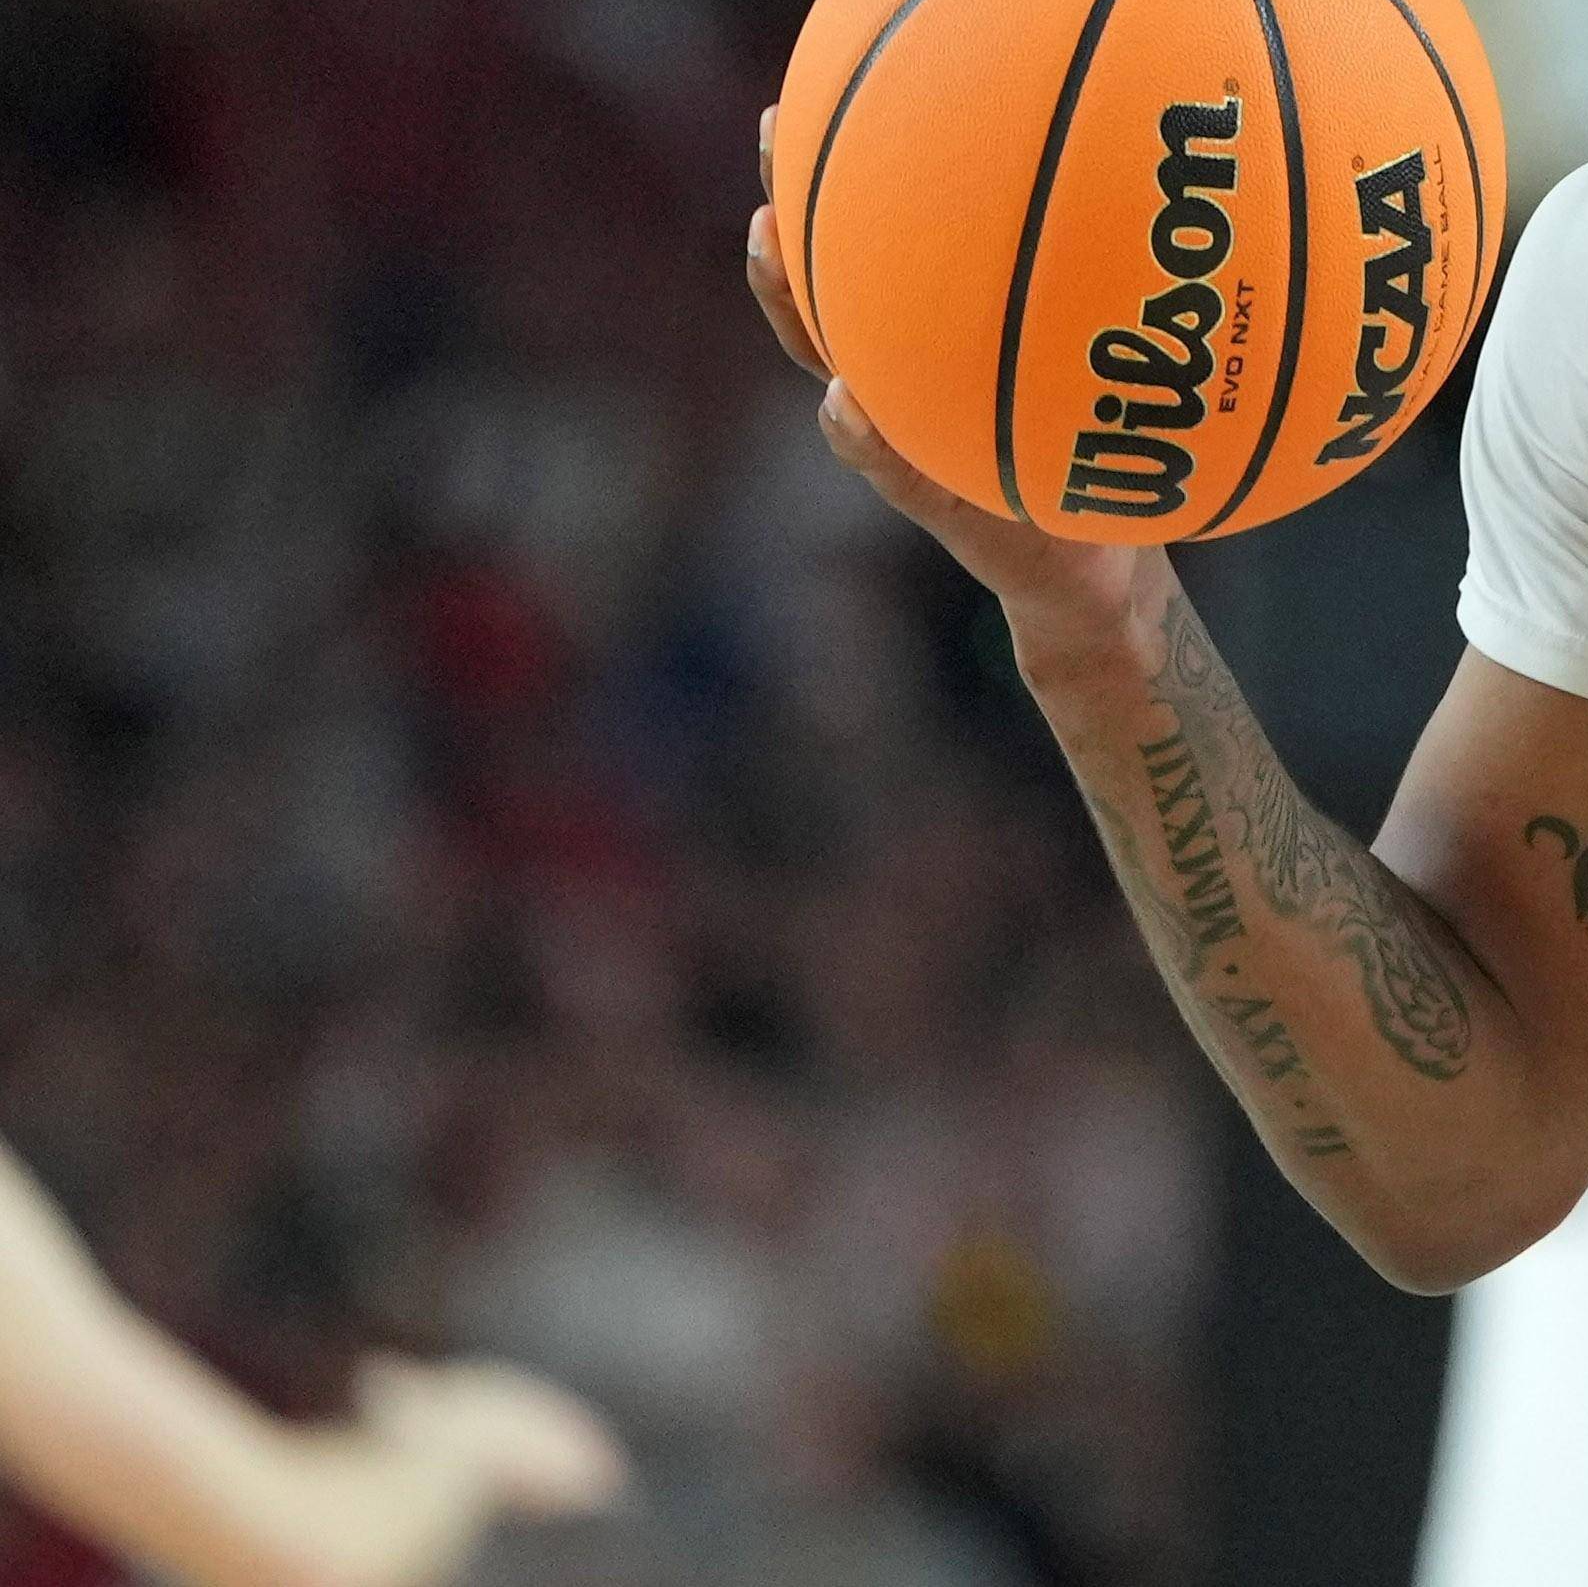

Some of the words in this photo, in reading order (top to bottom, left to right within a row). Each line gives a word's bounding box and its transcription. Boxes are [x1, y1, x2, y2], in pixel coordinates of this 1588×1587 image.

[1433, 143, 1449, 233] BALL
[1061, 95, 1243, 520] Wilson
[1231, 278, 1255, 345] NXT
[1315, 148, 1433, 465] NCAA
[1219, 355, 1244, 413] EVO
